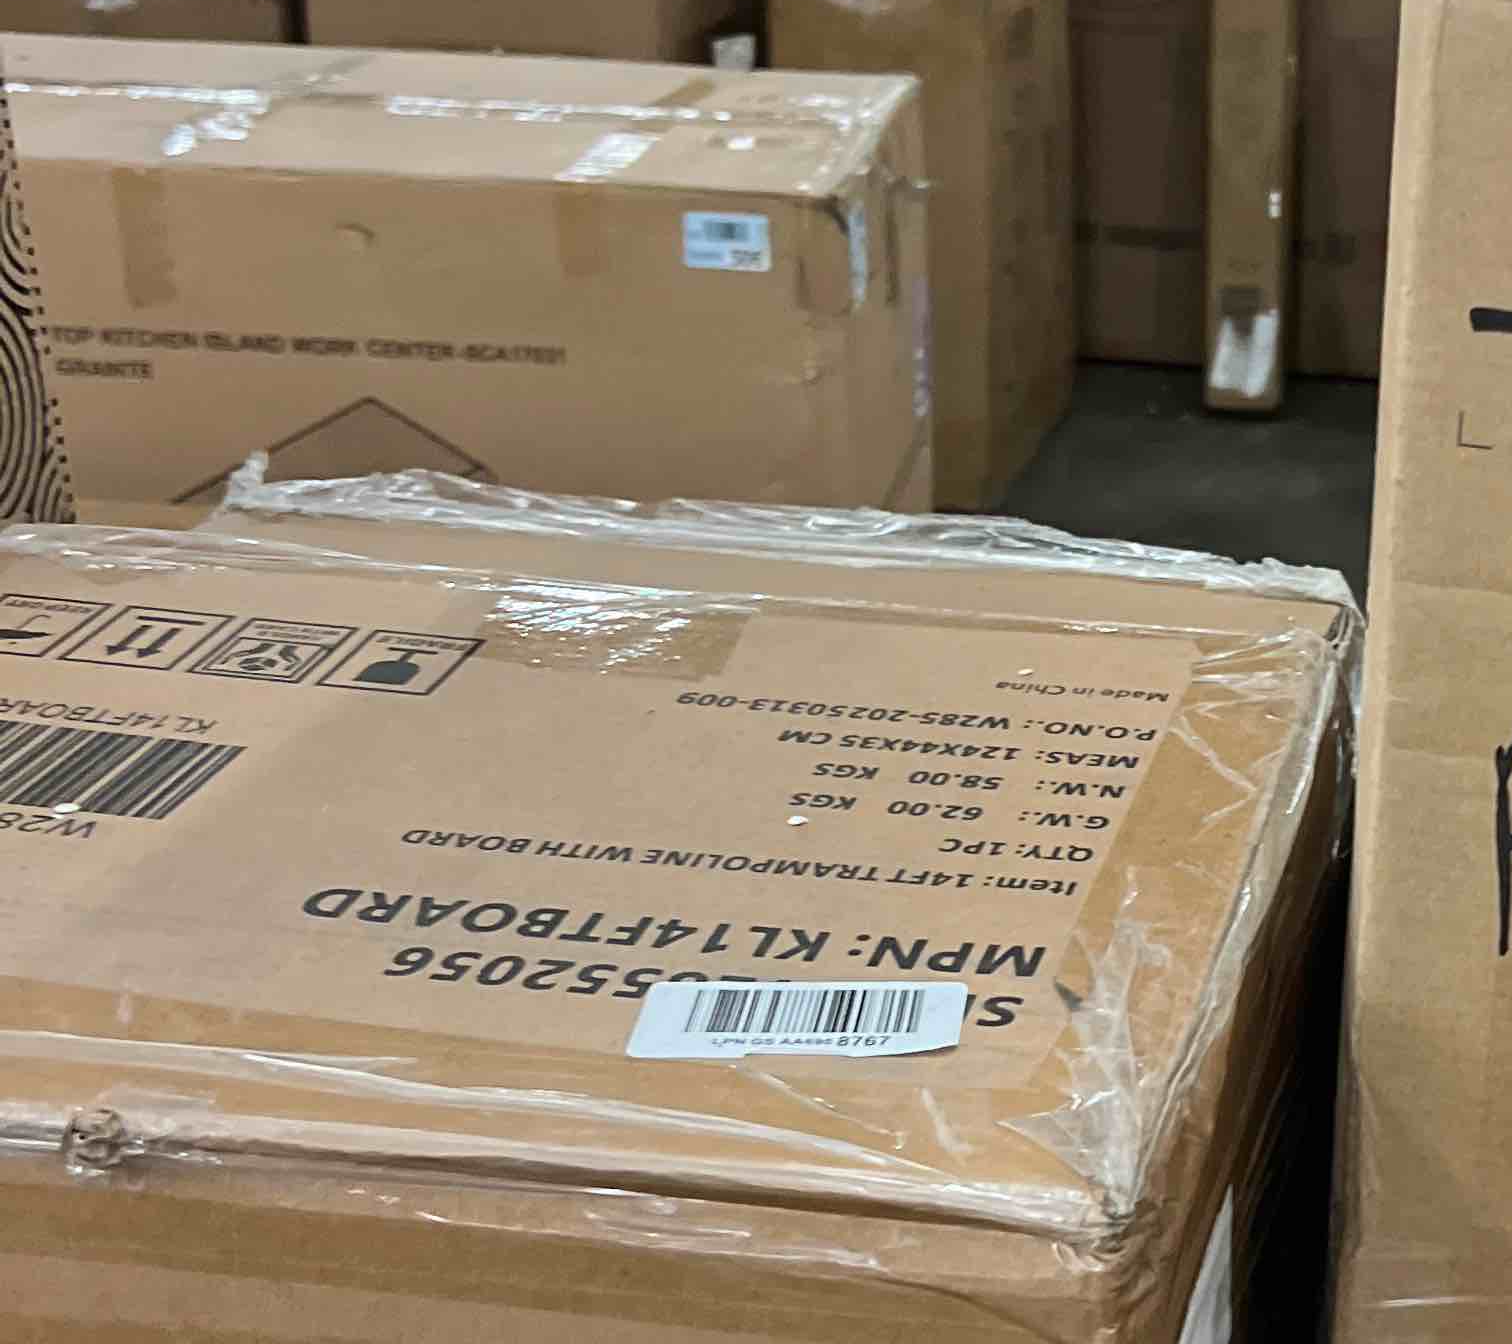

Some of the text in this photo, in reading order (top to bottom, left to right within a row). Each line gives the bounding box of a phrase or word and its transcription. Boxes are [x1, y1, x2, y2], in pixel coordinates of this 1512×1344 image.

[995, 679, 1169, 704] Made in China
[676, 690, 1158, 742] P.O.NO.: W285-20250313-009
[777, 729, 1140, 770] MEAS: 124X44X35 CM
[812, 761, 1126, 800] N.W.: 58.00 KGS
[788, 792, 1110, 831] G.W.: 62.00 KGS
[401, 828, 1078, 897] Item: 14FT TRAMPOLINE WITH BOARD
[938, 837, 1095, 864] QTY: 1PC
[302, 886, 1046, 979] MPN: KL14FTBOARD
